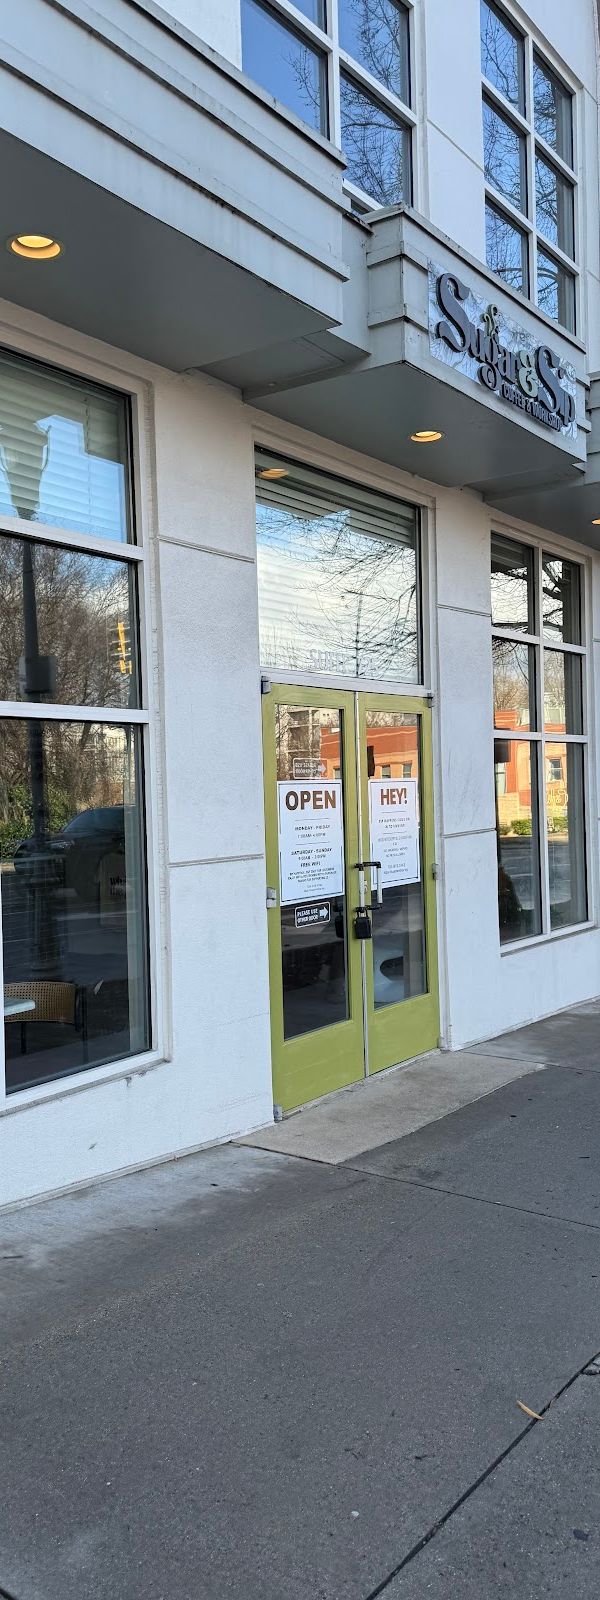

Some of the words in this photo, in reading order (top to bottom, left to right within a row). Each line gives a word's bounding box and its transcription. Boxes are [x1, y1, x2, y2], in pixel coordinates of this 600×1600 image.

[435, 272, 518, 391] Sugar
[535, 345, 575, 427] Sip
[502, 383, 526, 410] COFFEE
[530, 401, 561, 432] WORKSHOP
[285, 790, 337, 811] OPEN
[380, 788, 408, 806] HEY!
[297, 909, 311, 917] PLEASE
